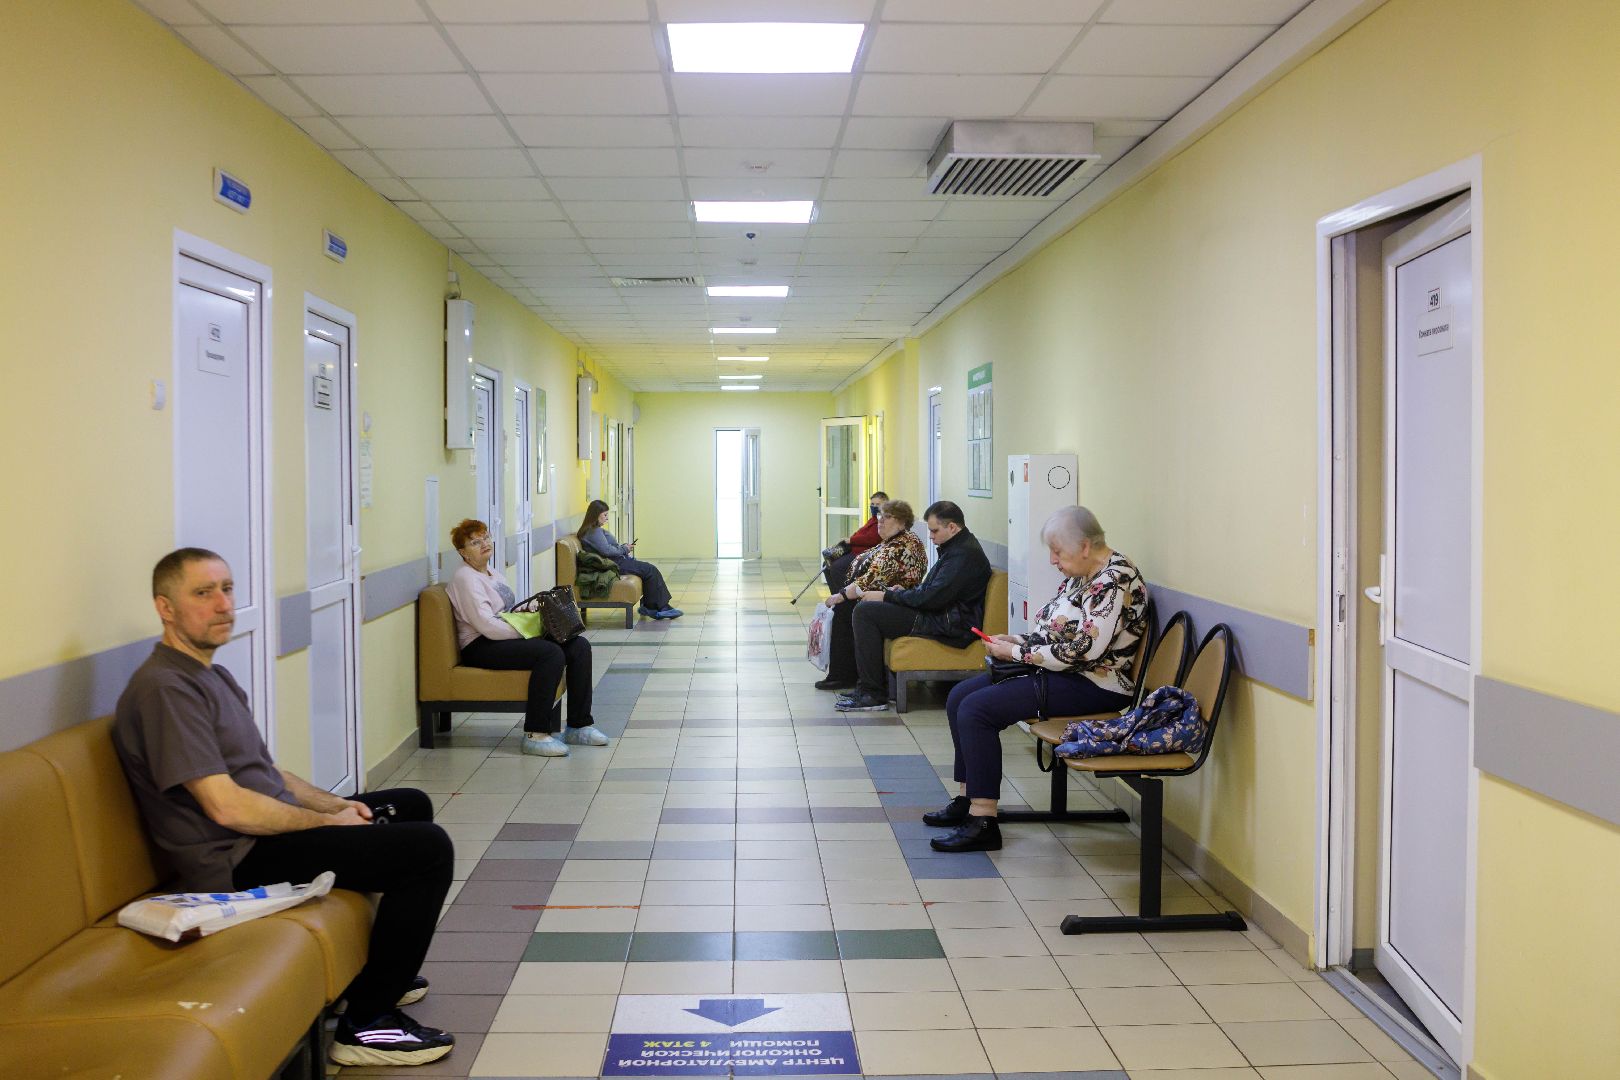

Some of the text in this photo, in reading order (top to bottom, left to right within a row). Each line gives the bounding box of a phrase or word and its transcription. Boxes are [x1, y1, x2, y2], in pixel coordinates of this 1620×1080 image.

[643, 1040, 820, 1048] ПОМОЩИ 4 ЭТАЖ
[641, 1049, 822, 1057] ОНКОЛОГИЧЕСКОЙ
[618, 1057, 844, 1068] ЦЕНТР АМБУЛАТОРНОЙ
